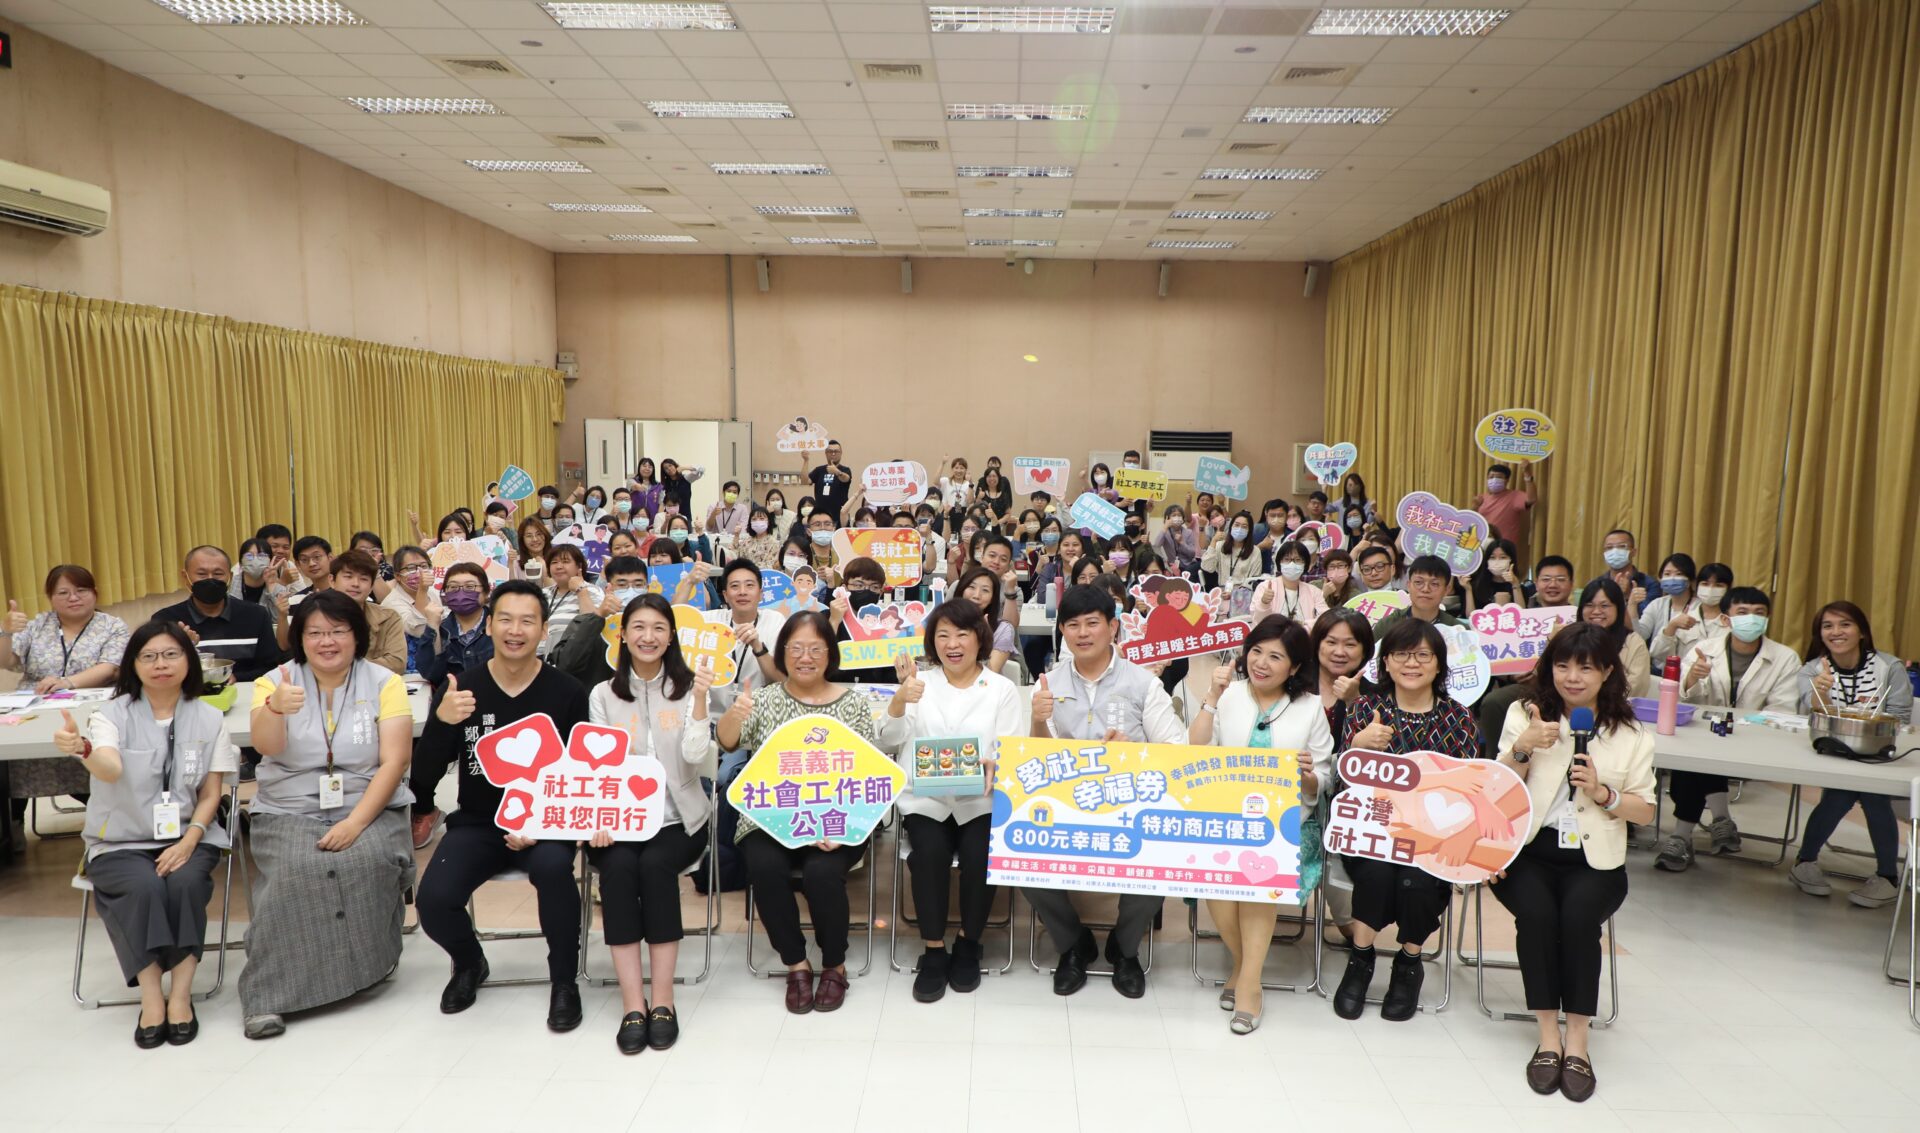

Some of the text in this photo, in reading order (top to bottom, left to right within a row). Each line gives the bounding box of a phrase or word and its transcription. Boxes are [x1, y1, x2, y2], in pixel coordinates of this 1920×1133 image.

[1493, 415, 1539, 436] 社工
[1485, 435, 1548, 456] 不是志工
[870, 465, 905, 476] 助人專業
[1201, 458, 1226, 470] Love
[1203, 470, 1211, 480] &
[871, 477, 906, 487] 莫忘初衷
[1116, 478, 1164, 491] 社工不是志工
[1197, 480, 1228, 495] Peace
[1405, 505, 1462, 537] 我社工
[871, 542, 919, 558] 我社工
[1413, 533, 1474, 569] 我自豪
[680, 626, 719, 650] 價值
[1126, 626, 1244, 661] 用愛溫暖生命角落
[842, 644, 882, 662] S.W.
[779, 749, 855, 776] 嘉義市
[1016, 746, 1110, 794] 愛社工
[1170, 755, 1279, 780] 幸福煥發 龍耀抵嘉
[1346, 756, 1410, 786] 0402
[543, 774, 622, 800] 社工有
[742, 776, 892, 810] 社會工作師
[1073, 770, 1167, 811] 幸福券
[1186, 773, 1292, 789] 嘉義市113年度社工日活動
[541, 805, 648, 832] 與您同行
[1336, 792, 1393, 827] 台灣
[790, 807, 848, 838] 公會
[1142, 815, 1267, 841] 特約商店優惠
[1012, 828, 1131, 853] 800元幸福金
[1328, 825, 1416, 864] 社工日
